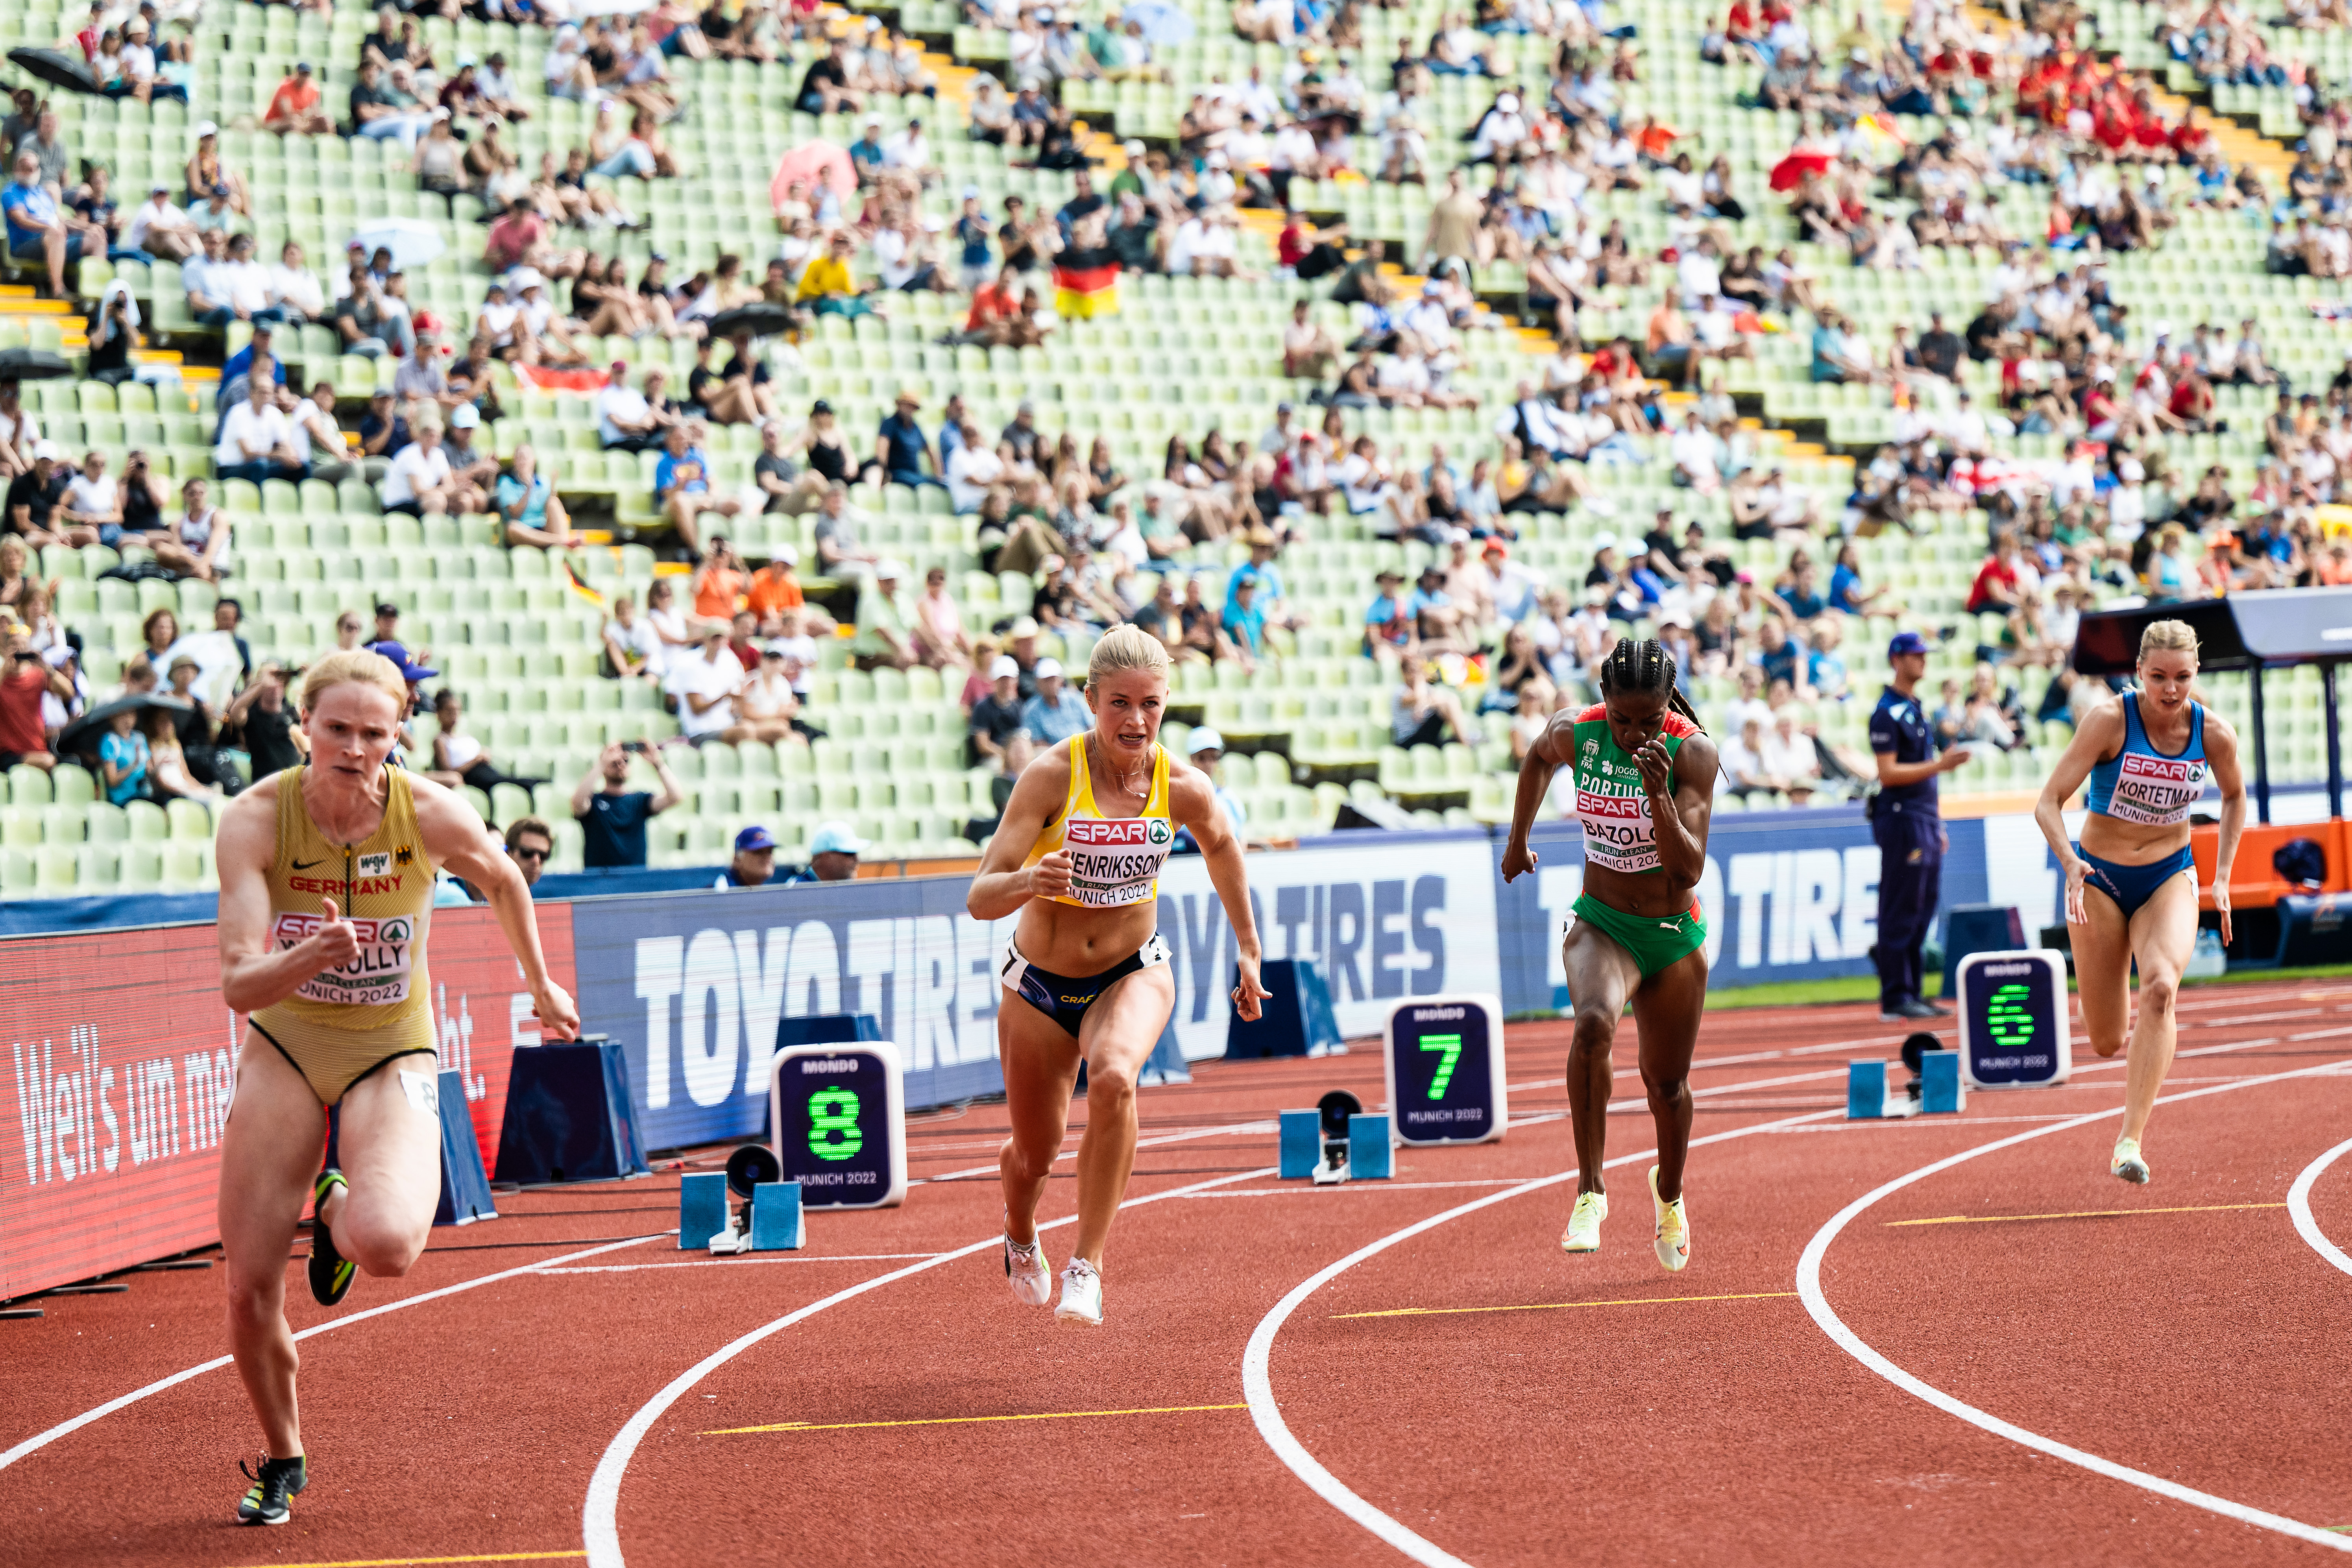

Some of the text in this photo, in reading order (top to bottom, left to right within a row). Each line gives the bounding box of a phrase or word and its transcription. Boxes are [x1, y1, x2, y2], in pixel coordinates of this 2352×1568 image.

[1581, 760, 1593, 771] FPA
[1614, 765, 1638, 776] JOGOS
[2125, 757, 2185, 779] SPAR
[1580, 772, 1644, 798] PORTUG
[2117, 779, 2198, 806] KORTETMAA
[1578, 794, 1638, 816] SPAR
[2114, 803, 2159, 824] MUNICH
[1070, 823, 1146, 842] SPAR
[1605, 846, 1619, 857] RUN
[1637, 853, 1661, 868] 202
[290, 874, 403, 896] GERMANY
[1086, 882, 1109, 890] RUN
[1119, 883, 1147, 901] 2022
[282, 918, 375, 942] SPR
[1277, 874, 1448, 1003] TIRES
[299, 983, 402, 1003] UNICH 2022
[1060, 994, 1096, 1004] CRAF
[635, 919, 843, 1109] TOYO
[1413, 1006, 1466, 1022] MONDO
[1988, 984, 2035, 1046] 6
[802, 1058, 859, 1075] MONDO
[1419, 1034, 1462, 1101] 7
[13, 1022, 120, 1186] Weil's
[125, 1056, 180, 1167] um
[807, 1086, 863, 1161] 8
[1407, 1110, 1453, 1124] MUNICH
[794, 1171, 877, 1187] MUNICH 2022
